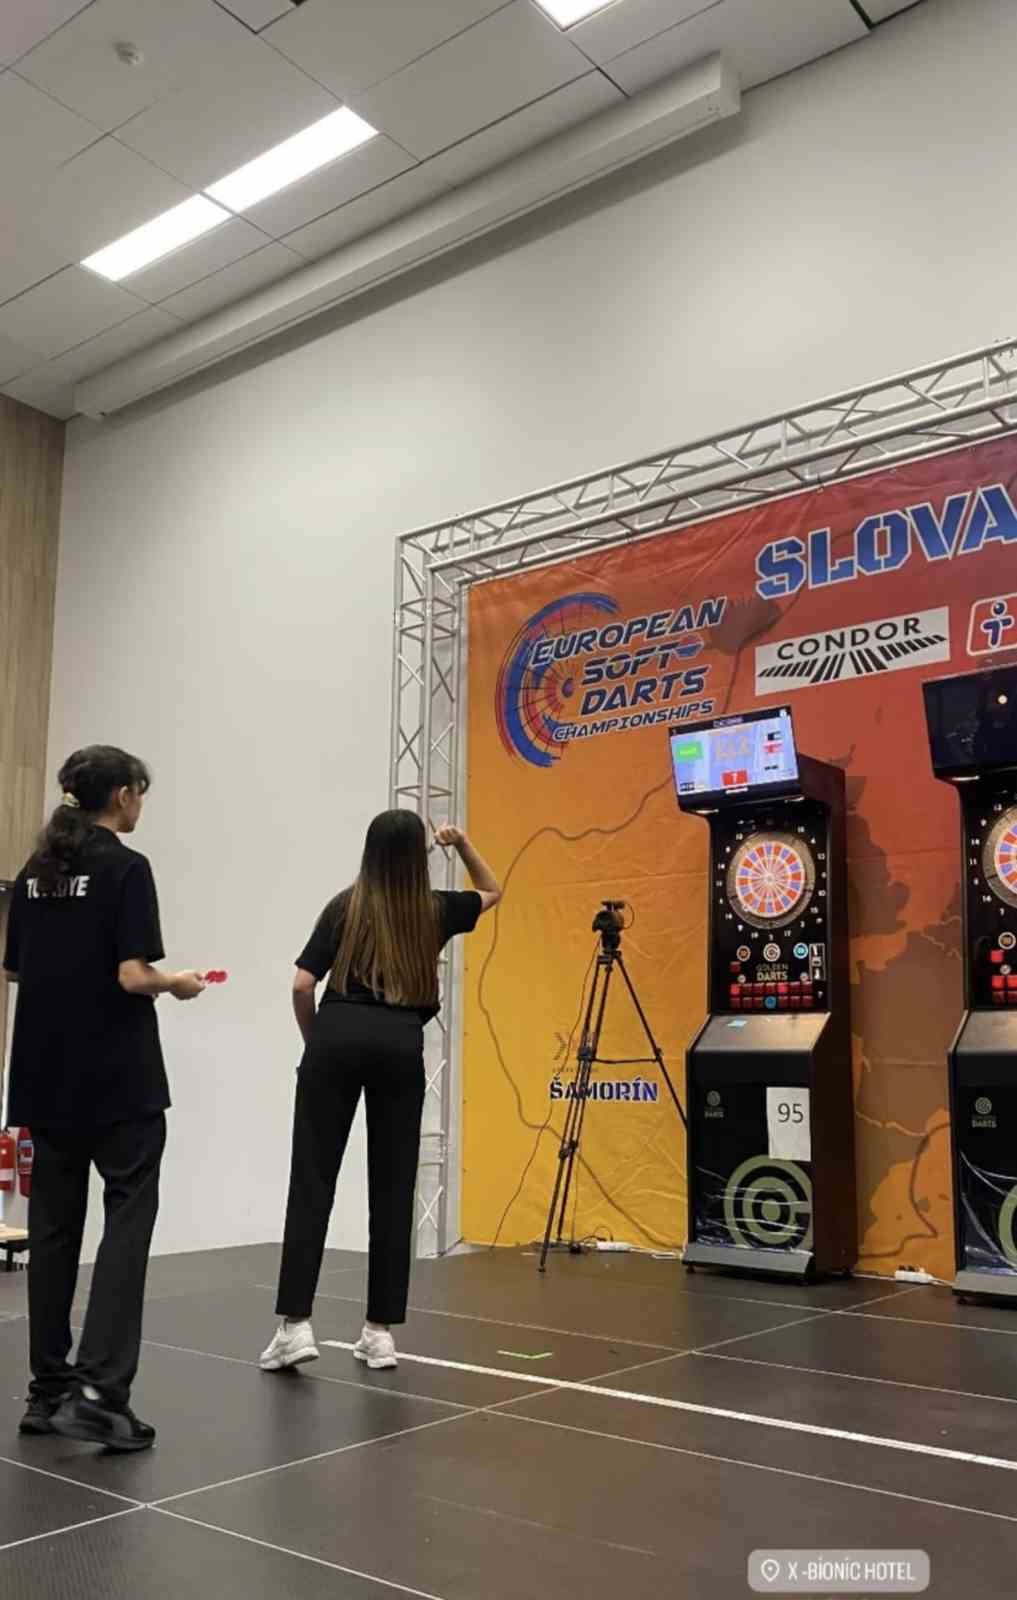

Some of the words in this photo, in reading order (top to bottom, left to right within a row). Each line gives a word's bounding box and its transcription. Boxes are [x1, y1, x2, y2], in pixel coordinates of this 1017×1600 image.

[755, 483, 1017, 600] SLOVA
[530, 596, 727, 666] EUROPEAN
[777, 617, 921, 660] CONDOR
[581, 642, 681, 686] SOFT
[580, 665, 710, 716] DARTS
[553, 700, 713, 742] CHAMPIONSHIPS
[756, 971, 788, 981] DARTS
[777, 1102, 804, 1124] 95
